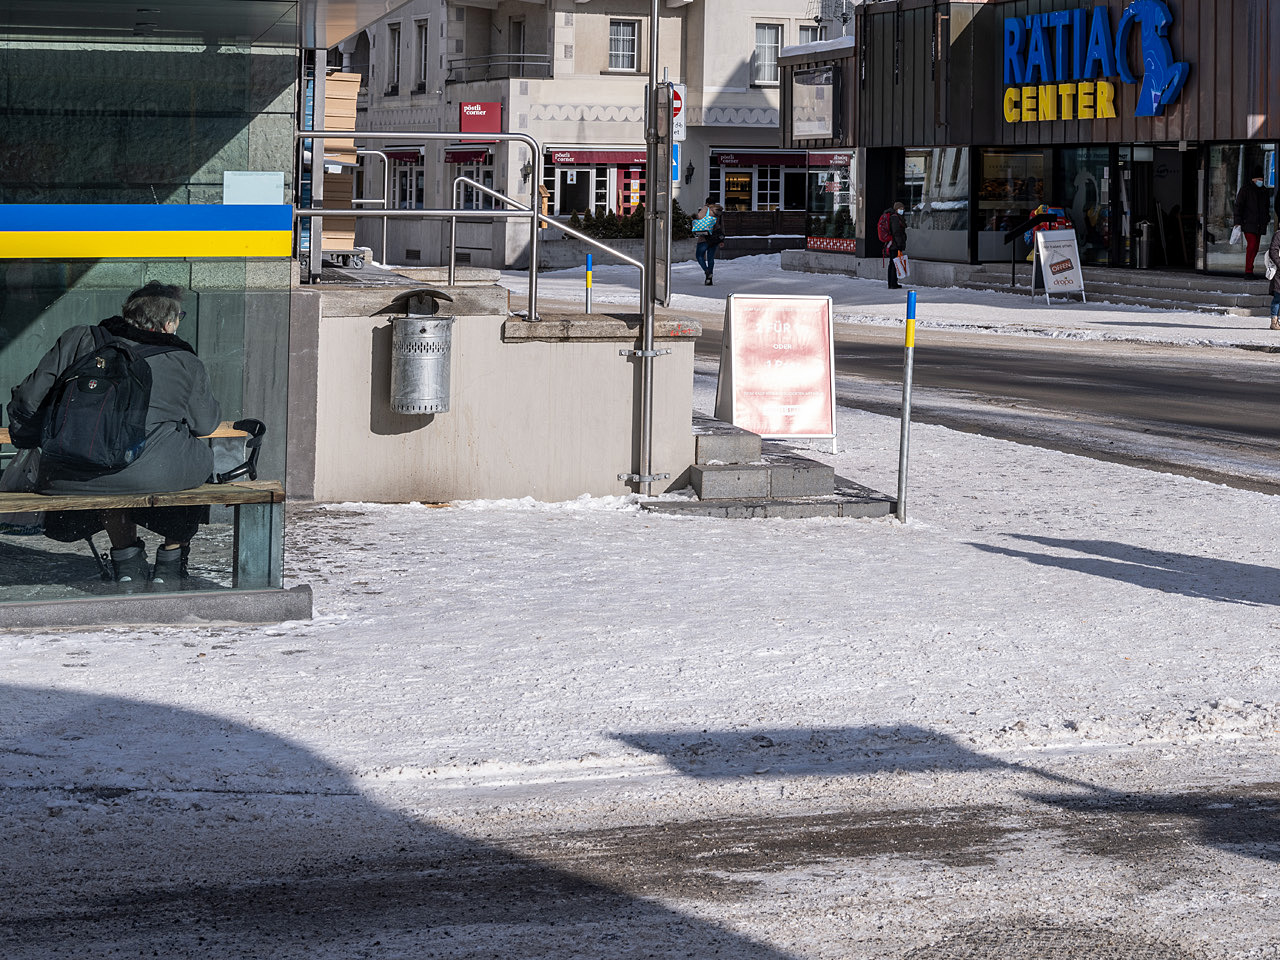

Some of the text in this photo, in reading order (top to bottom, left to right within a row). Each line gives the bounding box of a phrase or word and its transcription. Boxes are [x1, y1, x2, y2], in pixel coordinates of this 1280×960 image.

[1004, 5, 1120, 84] RÄTIA
[463, 104, 481, 113] pöstli
[1004, 81, 1117, 123] CENTER
[1052, 262, 1071, 272] OFFEN
